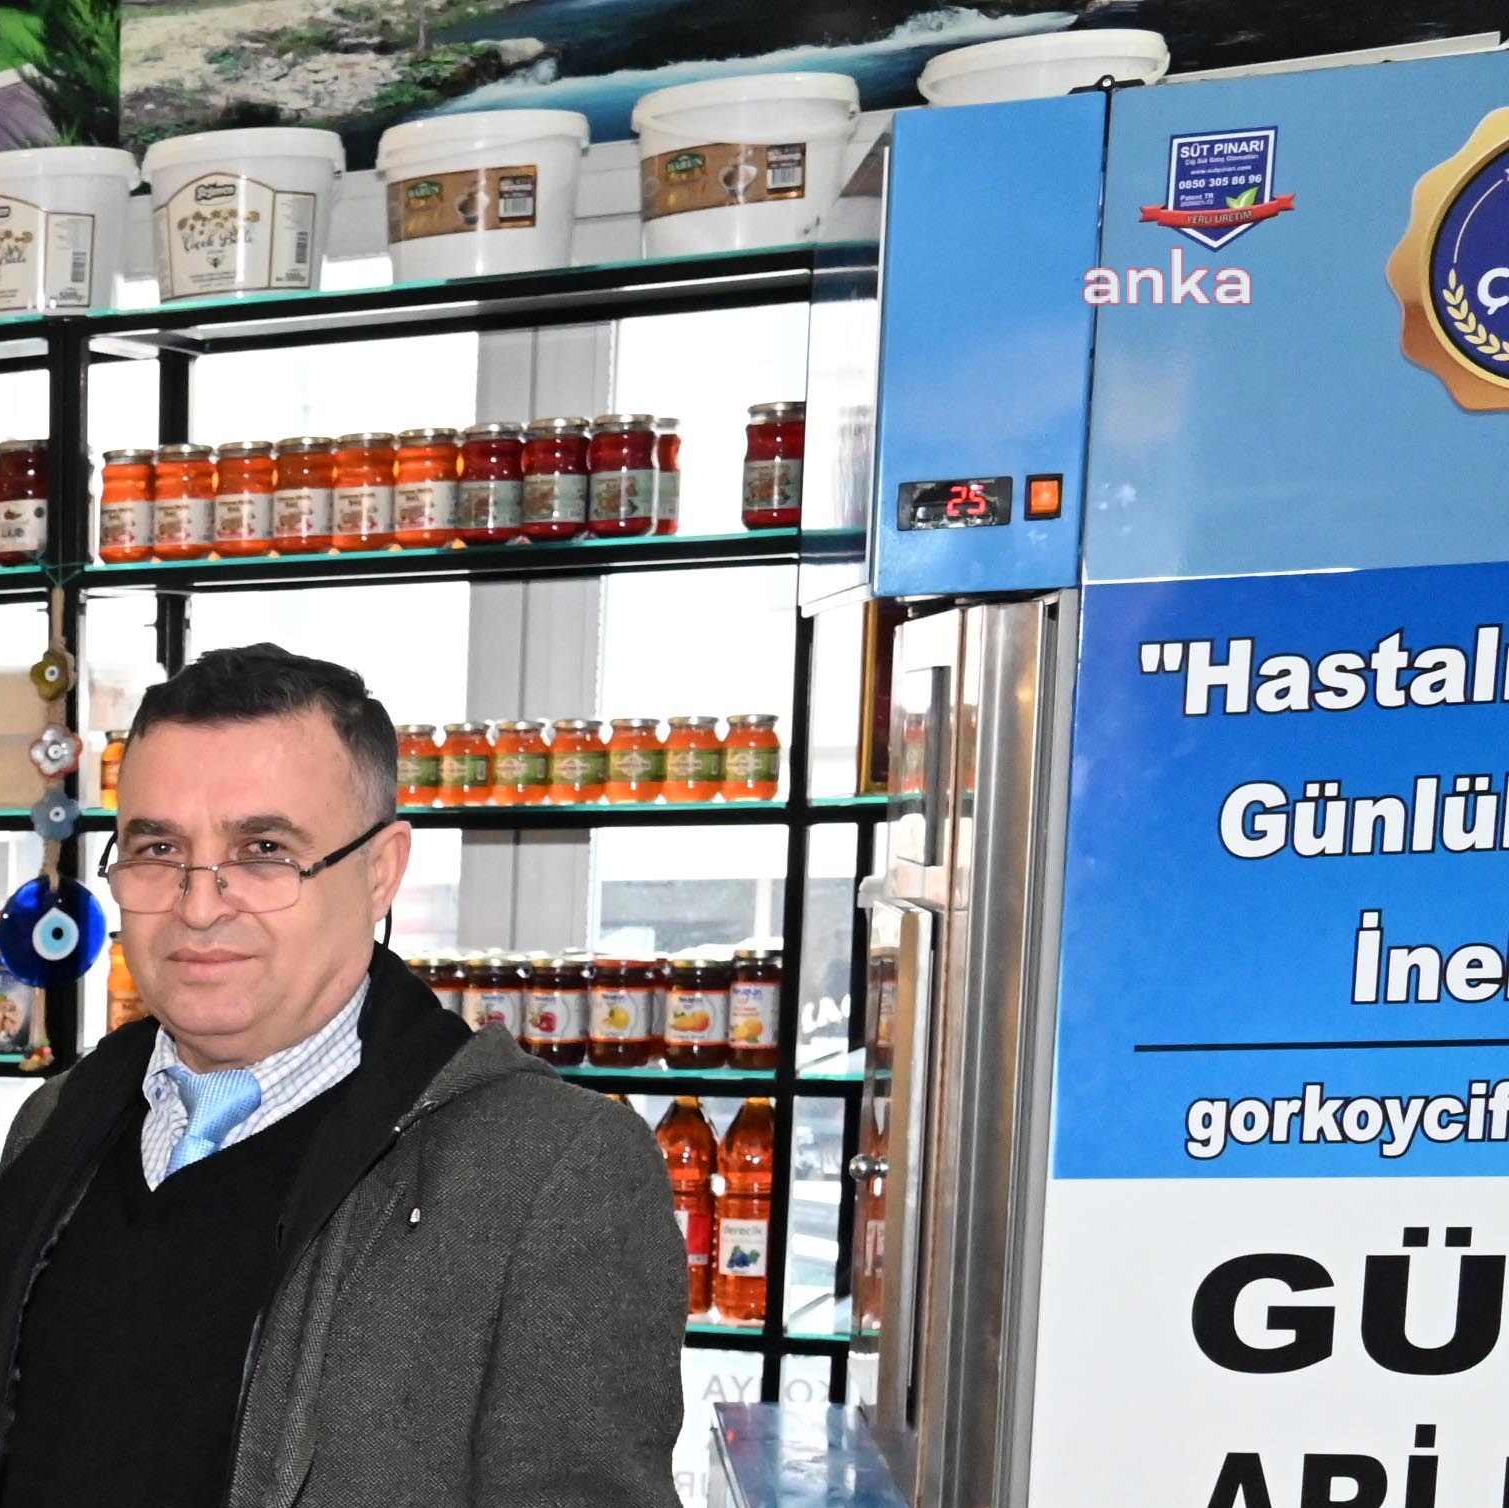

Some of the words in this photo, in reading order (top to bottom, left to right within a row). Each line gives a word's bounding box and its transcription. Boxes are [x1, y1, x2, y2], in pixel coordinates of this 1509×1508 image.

[1179, 179, 1205, 190] 0850
[1209, 178, 1228, 188] 305
[1232, 175, 1245, 186] 86
[1249, 174, 1262, 184] 96
[1214, 140, 1264, 155] PINARI
[947, 484, 987, 517] 25
[1140, 624, 1509, 716] "Hastal
[1219, 774, 1509, 860] Günlü
[1351, 908, 1509, 1004] İne
[1191, 1226, 1507, 1376] GÜ
